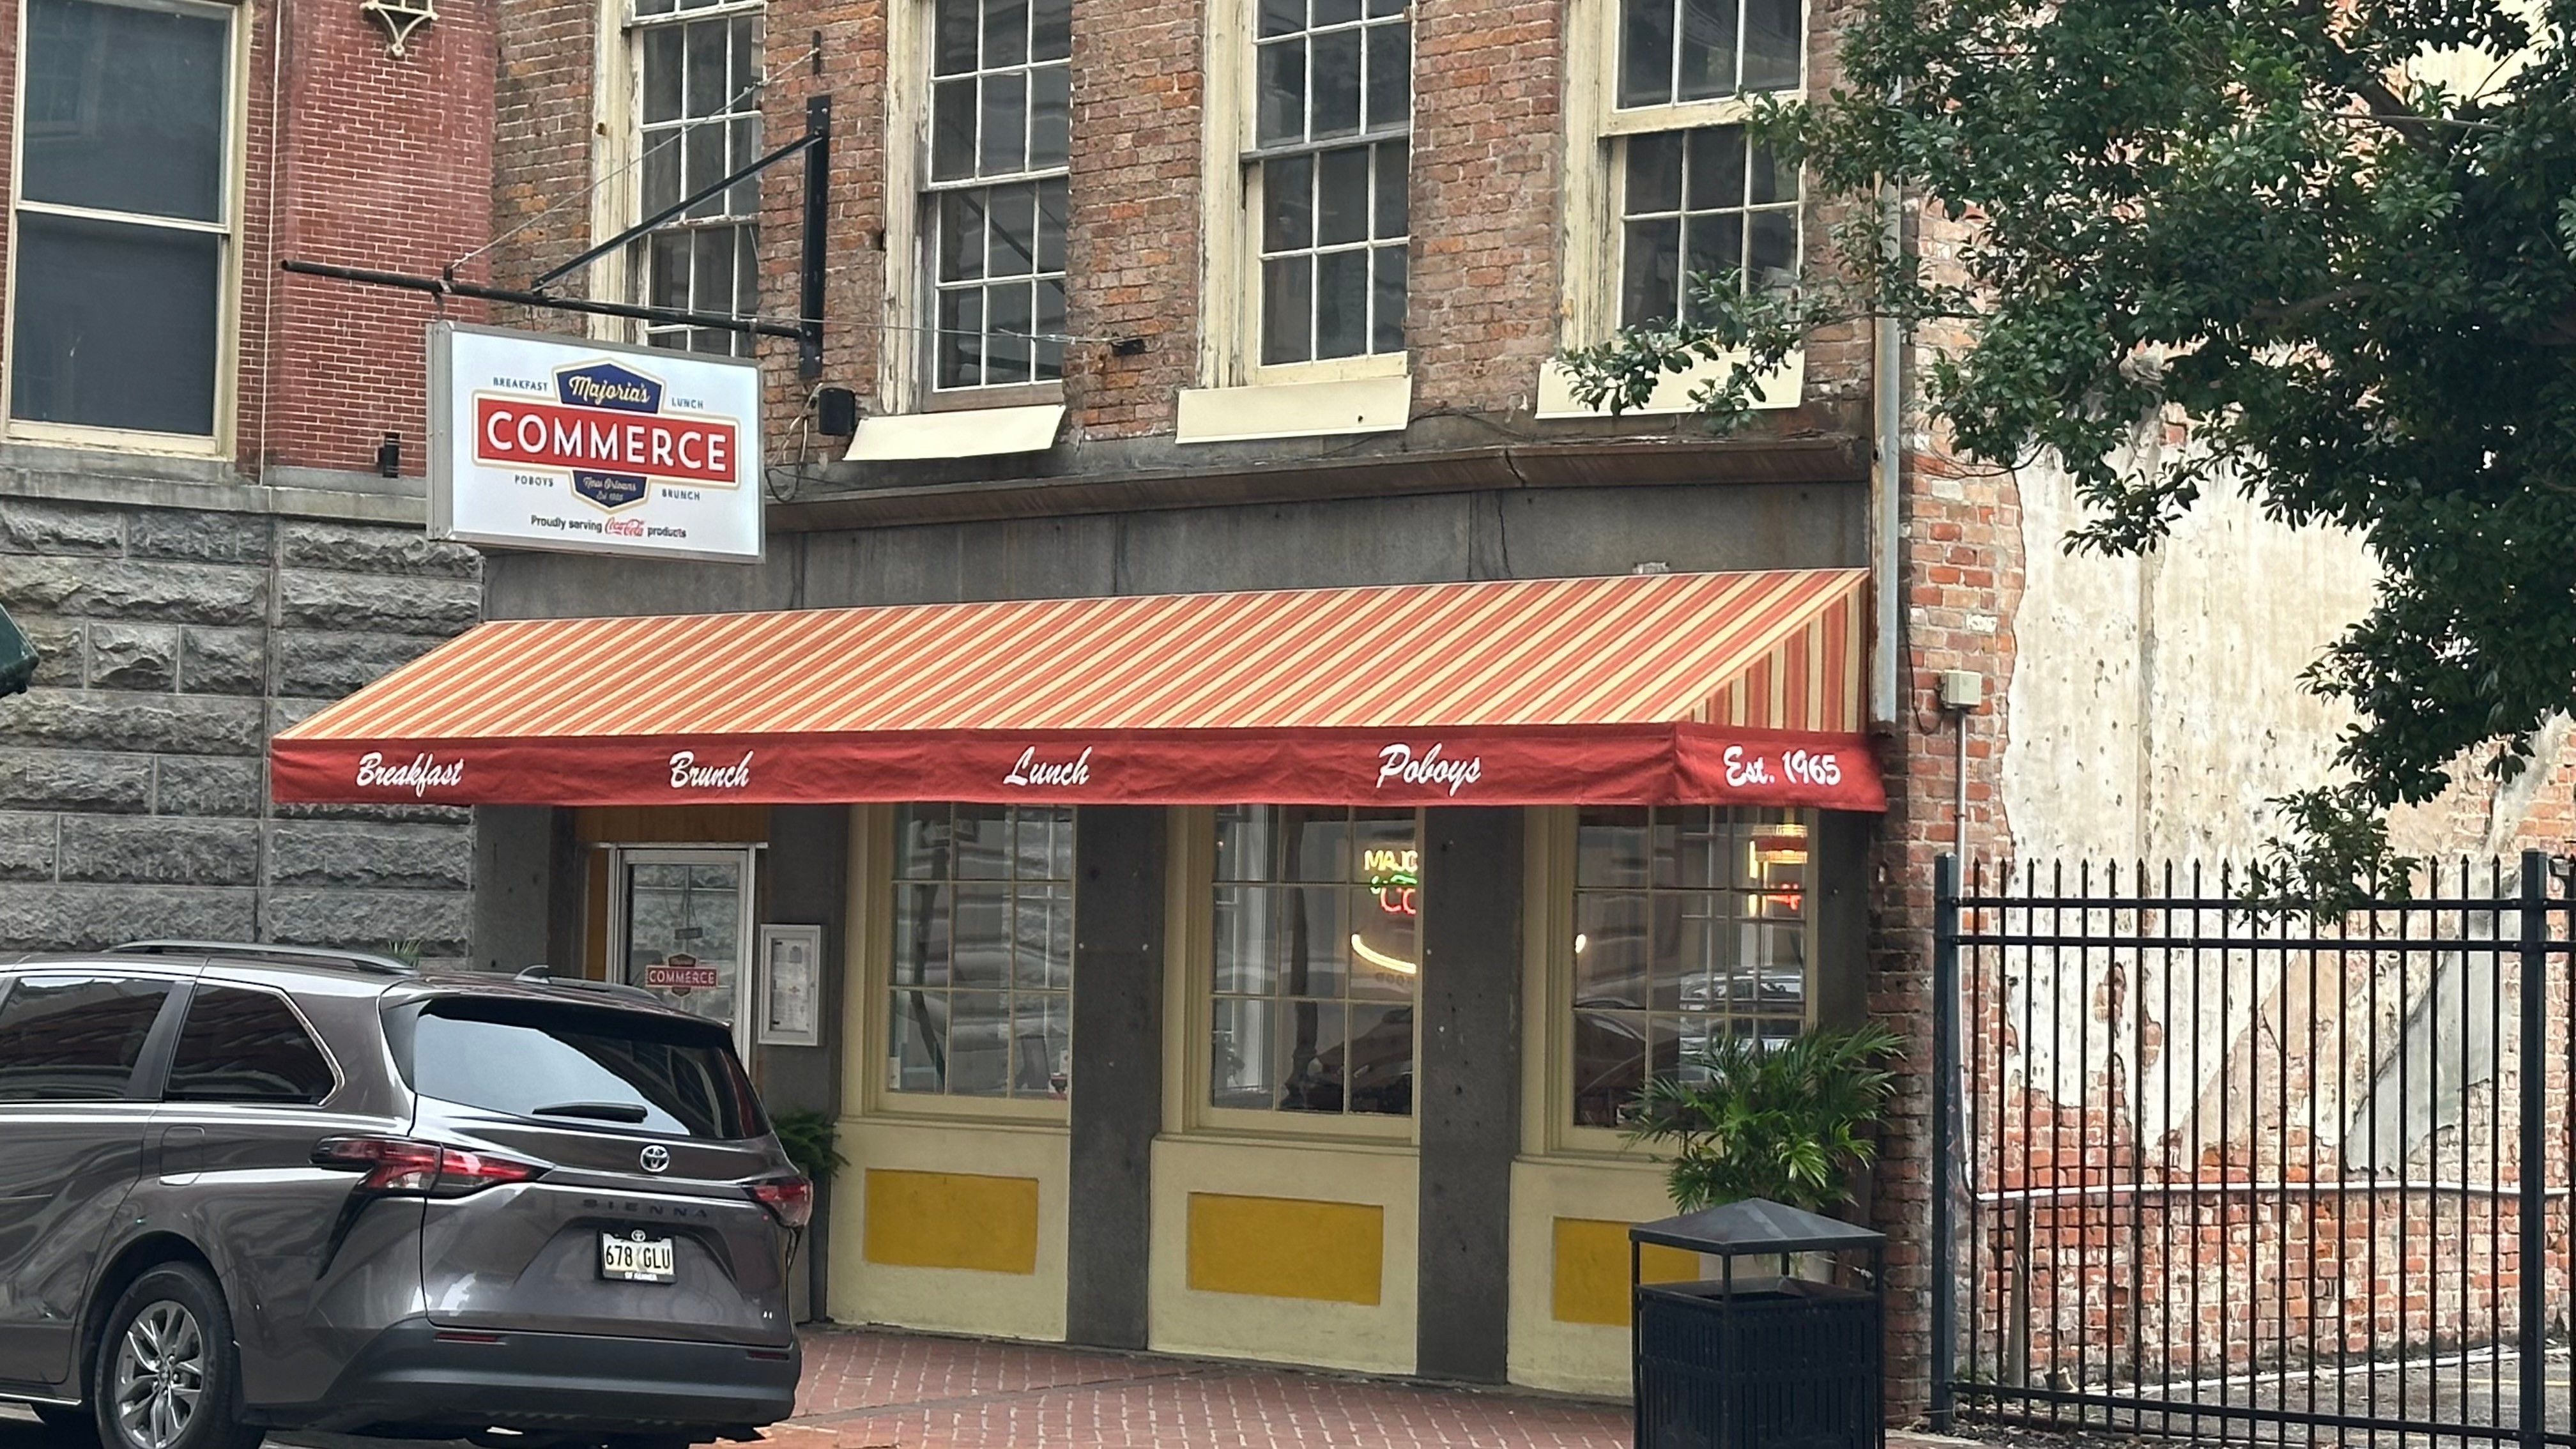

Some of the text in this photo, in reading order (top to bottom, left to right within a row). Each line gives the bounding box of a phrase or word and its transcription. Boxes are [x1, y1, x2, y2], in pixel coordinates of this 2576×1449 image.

[493, 376, 548, 391] BREAKFAST
[569, 375, 650, 405] Majoria's
[671, 397, 704, 410] LUNCH
[487, 411, 727, 472] COMMERCE
[515, 475, 554, 487] POBOYS
[662, 489, 700, 501] BRUNCH
[531, 515, 566, 530] Proudly
[569, 519, 602, 533] serving
[647, 526, 687, 538] products
[356, 751, 464, 798] Breakfast
[670, 750, 754, 788] Brunch
[1002, 746, 1092, 786] Lunch
[1376, 742, 1482, 797] Poboys
[1724, 745, 1841, 786] Est. 1965
[649, 970, 716, 985] COMMERCE
[583, 1198, 707, 1219] SIENNA
[606, 1245, 671, 1269] 678 GLU
